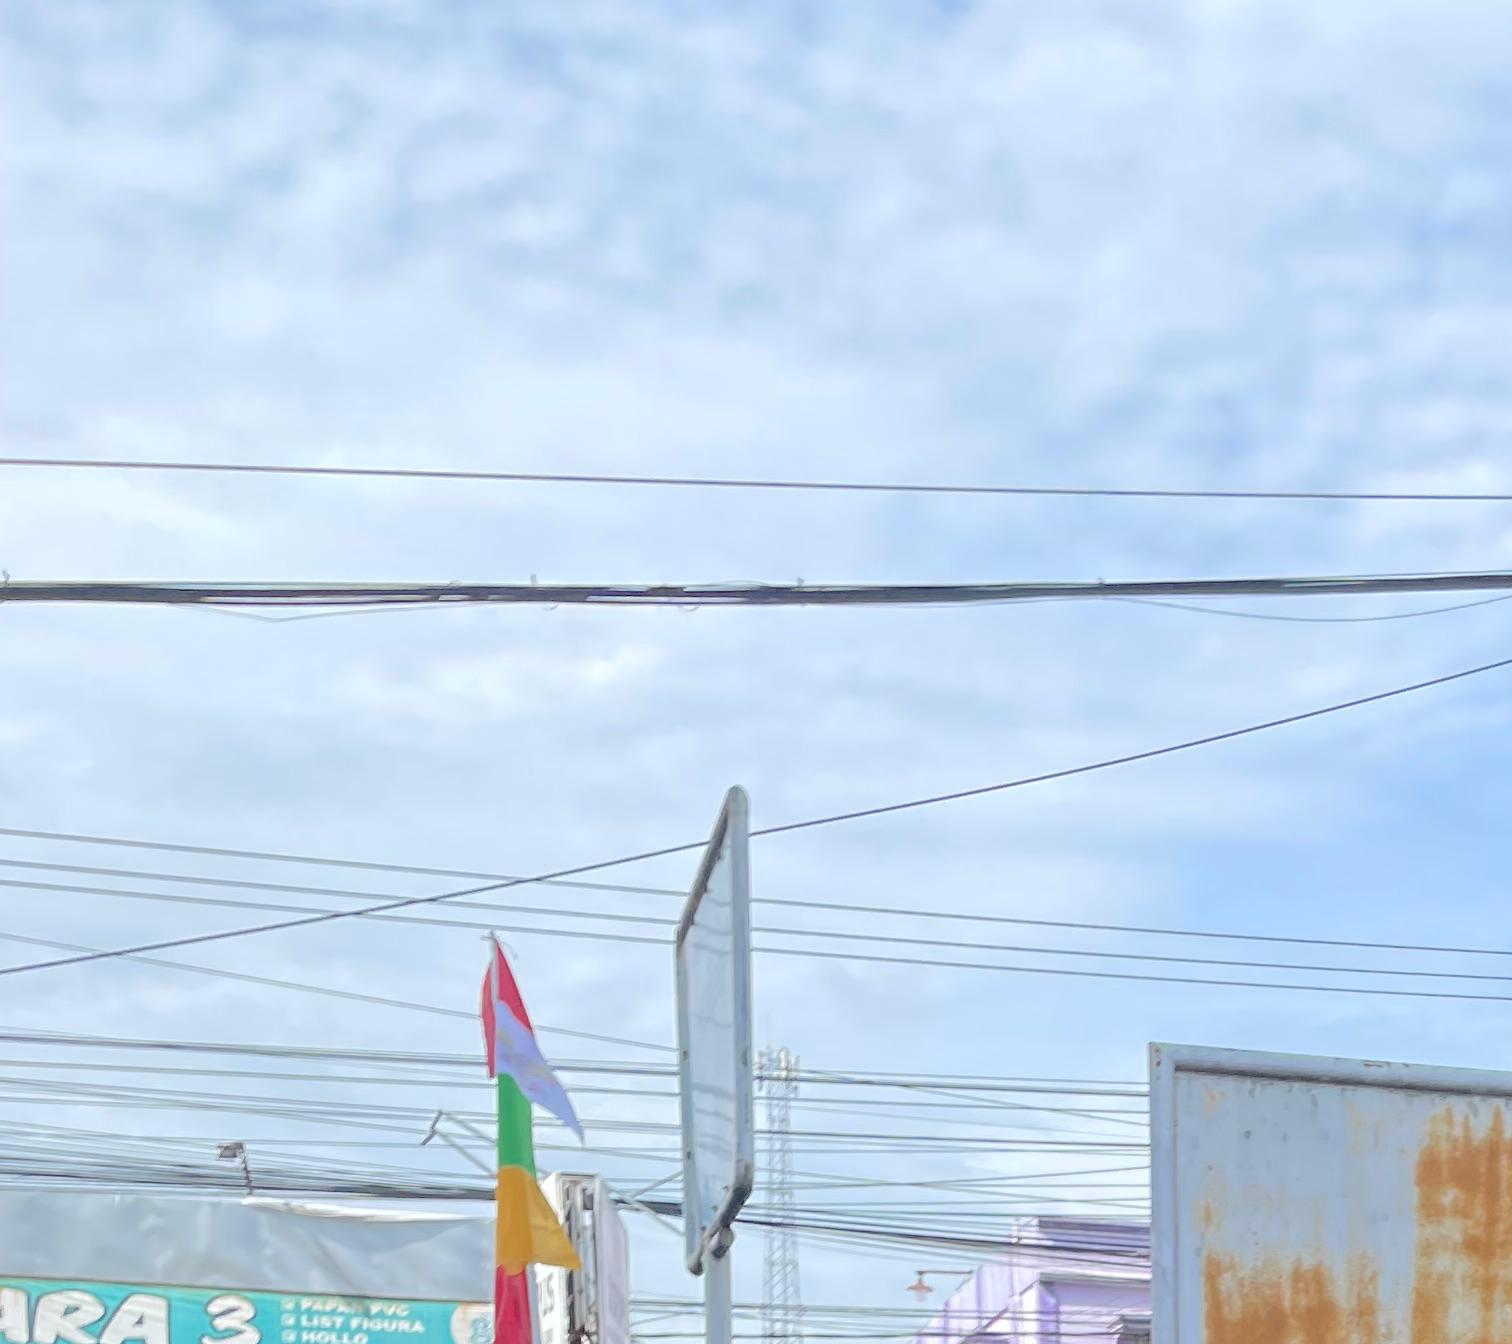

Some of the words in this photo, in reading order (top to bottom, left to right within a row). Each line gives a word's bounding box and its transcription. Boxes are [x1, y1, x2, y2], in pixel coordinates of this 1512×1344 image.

[369, 1302, 410, 1317] PVC
[300, 1314, 346, 1329] LIST
[350, 1317, 426, 1334] FIGURA
